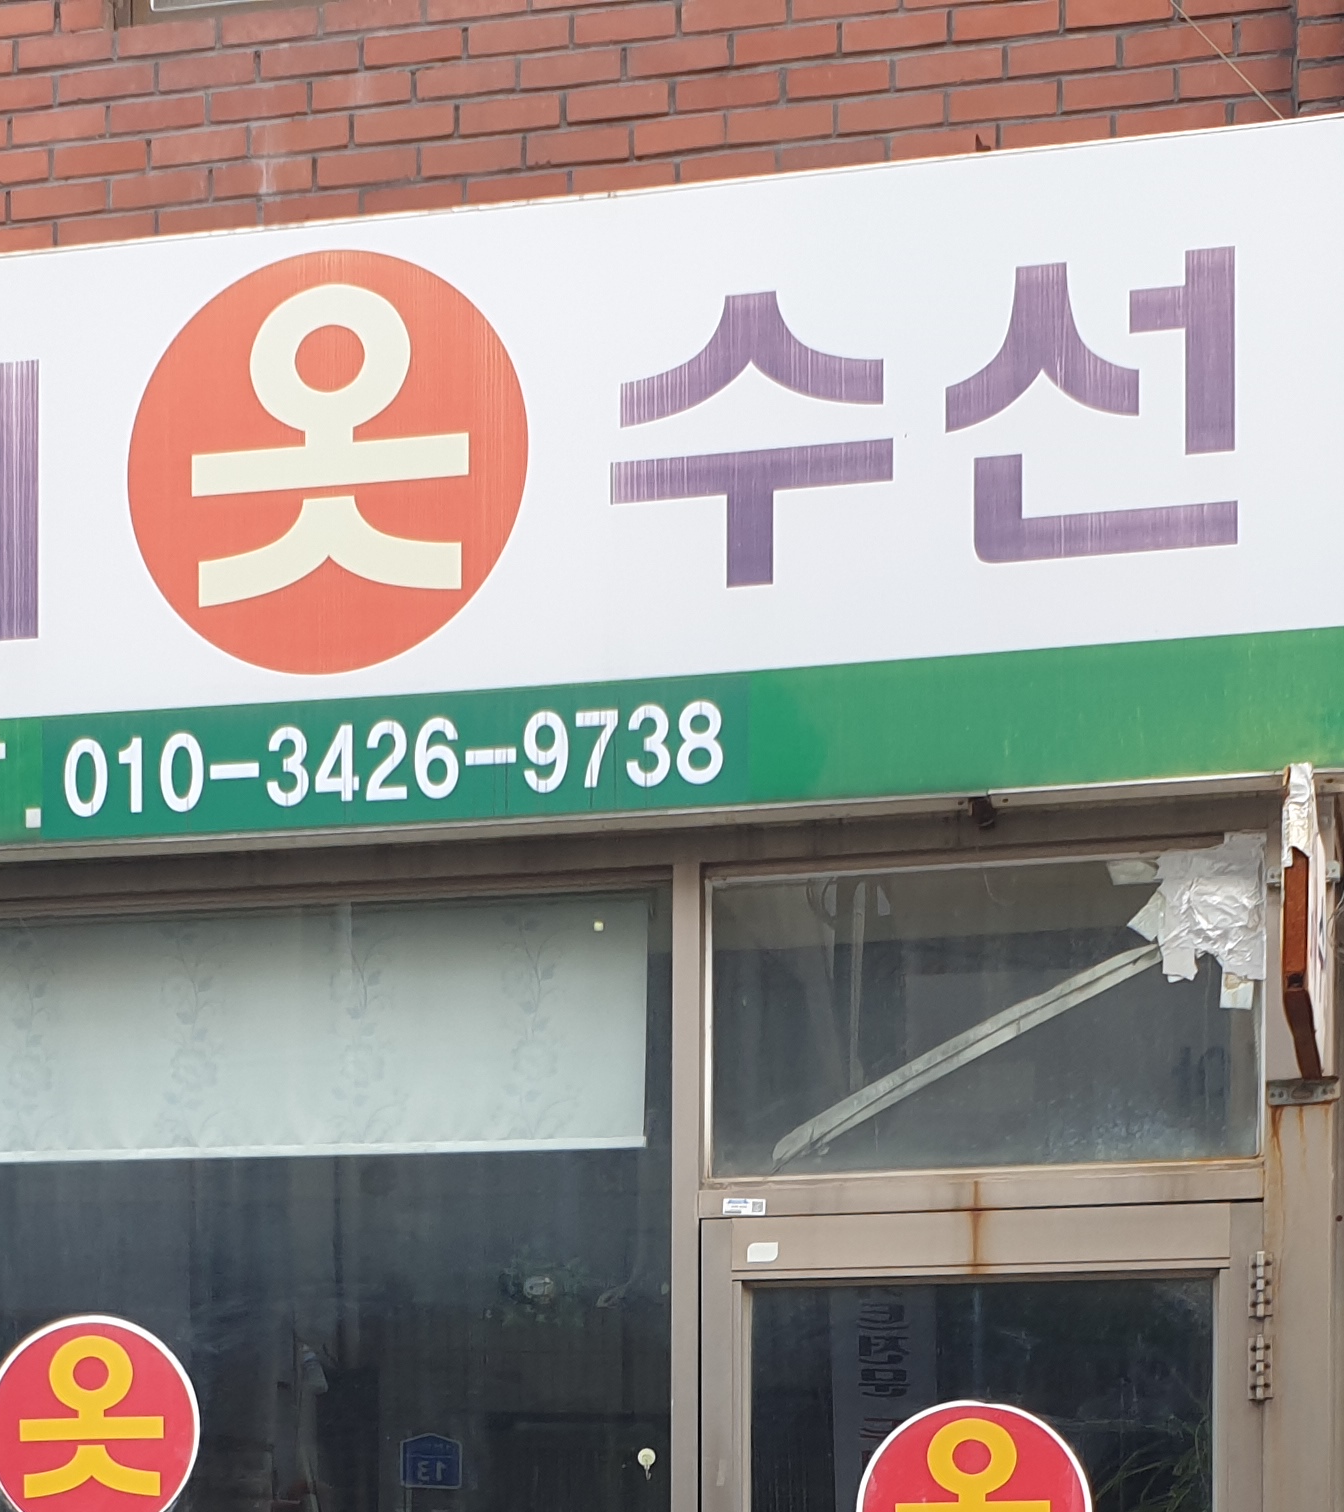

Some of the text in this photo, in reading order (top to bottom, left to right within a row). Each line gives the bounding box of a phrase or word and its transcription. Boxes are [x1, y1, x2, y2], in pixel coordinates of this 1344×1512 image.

[191, 284, 469, 608] 옷
[610, 246, 1239, 589] 수선
[19, 1334, 164, 1499] 옷
